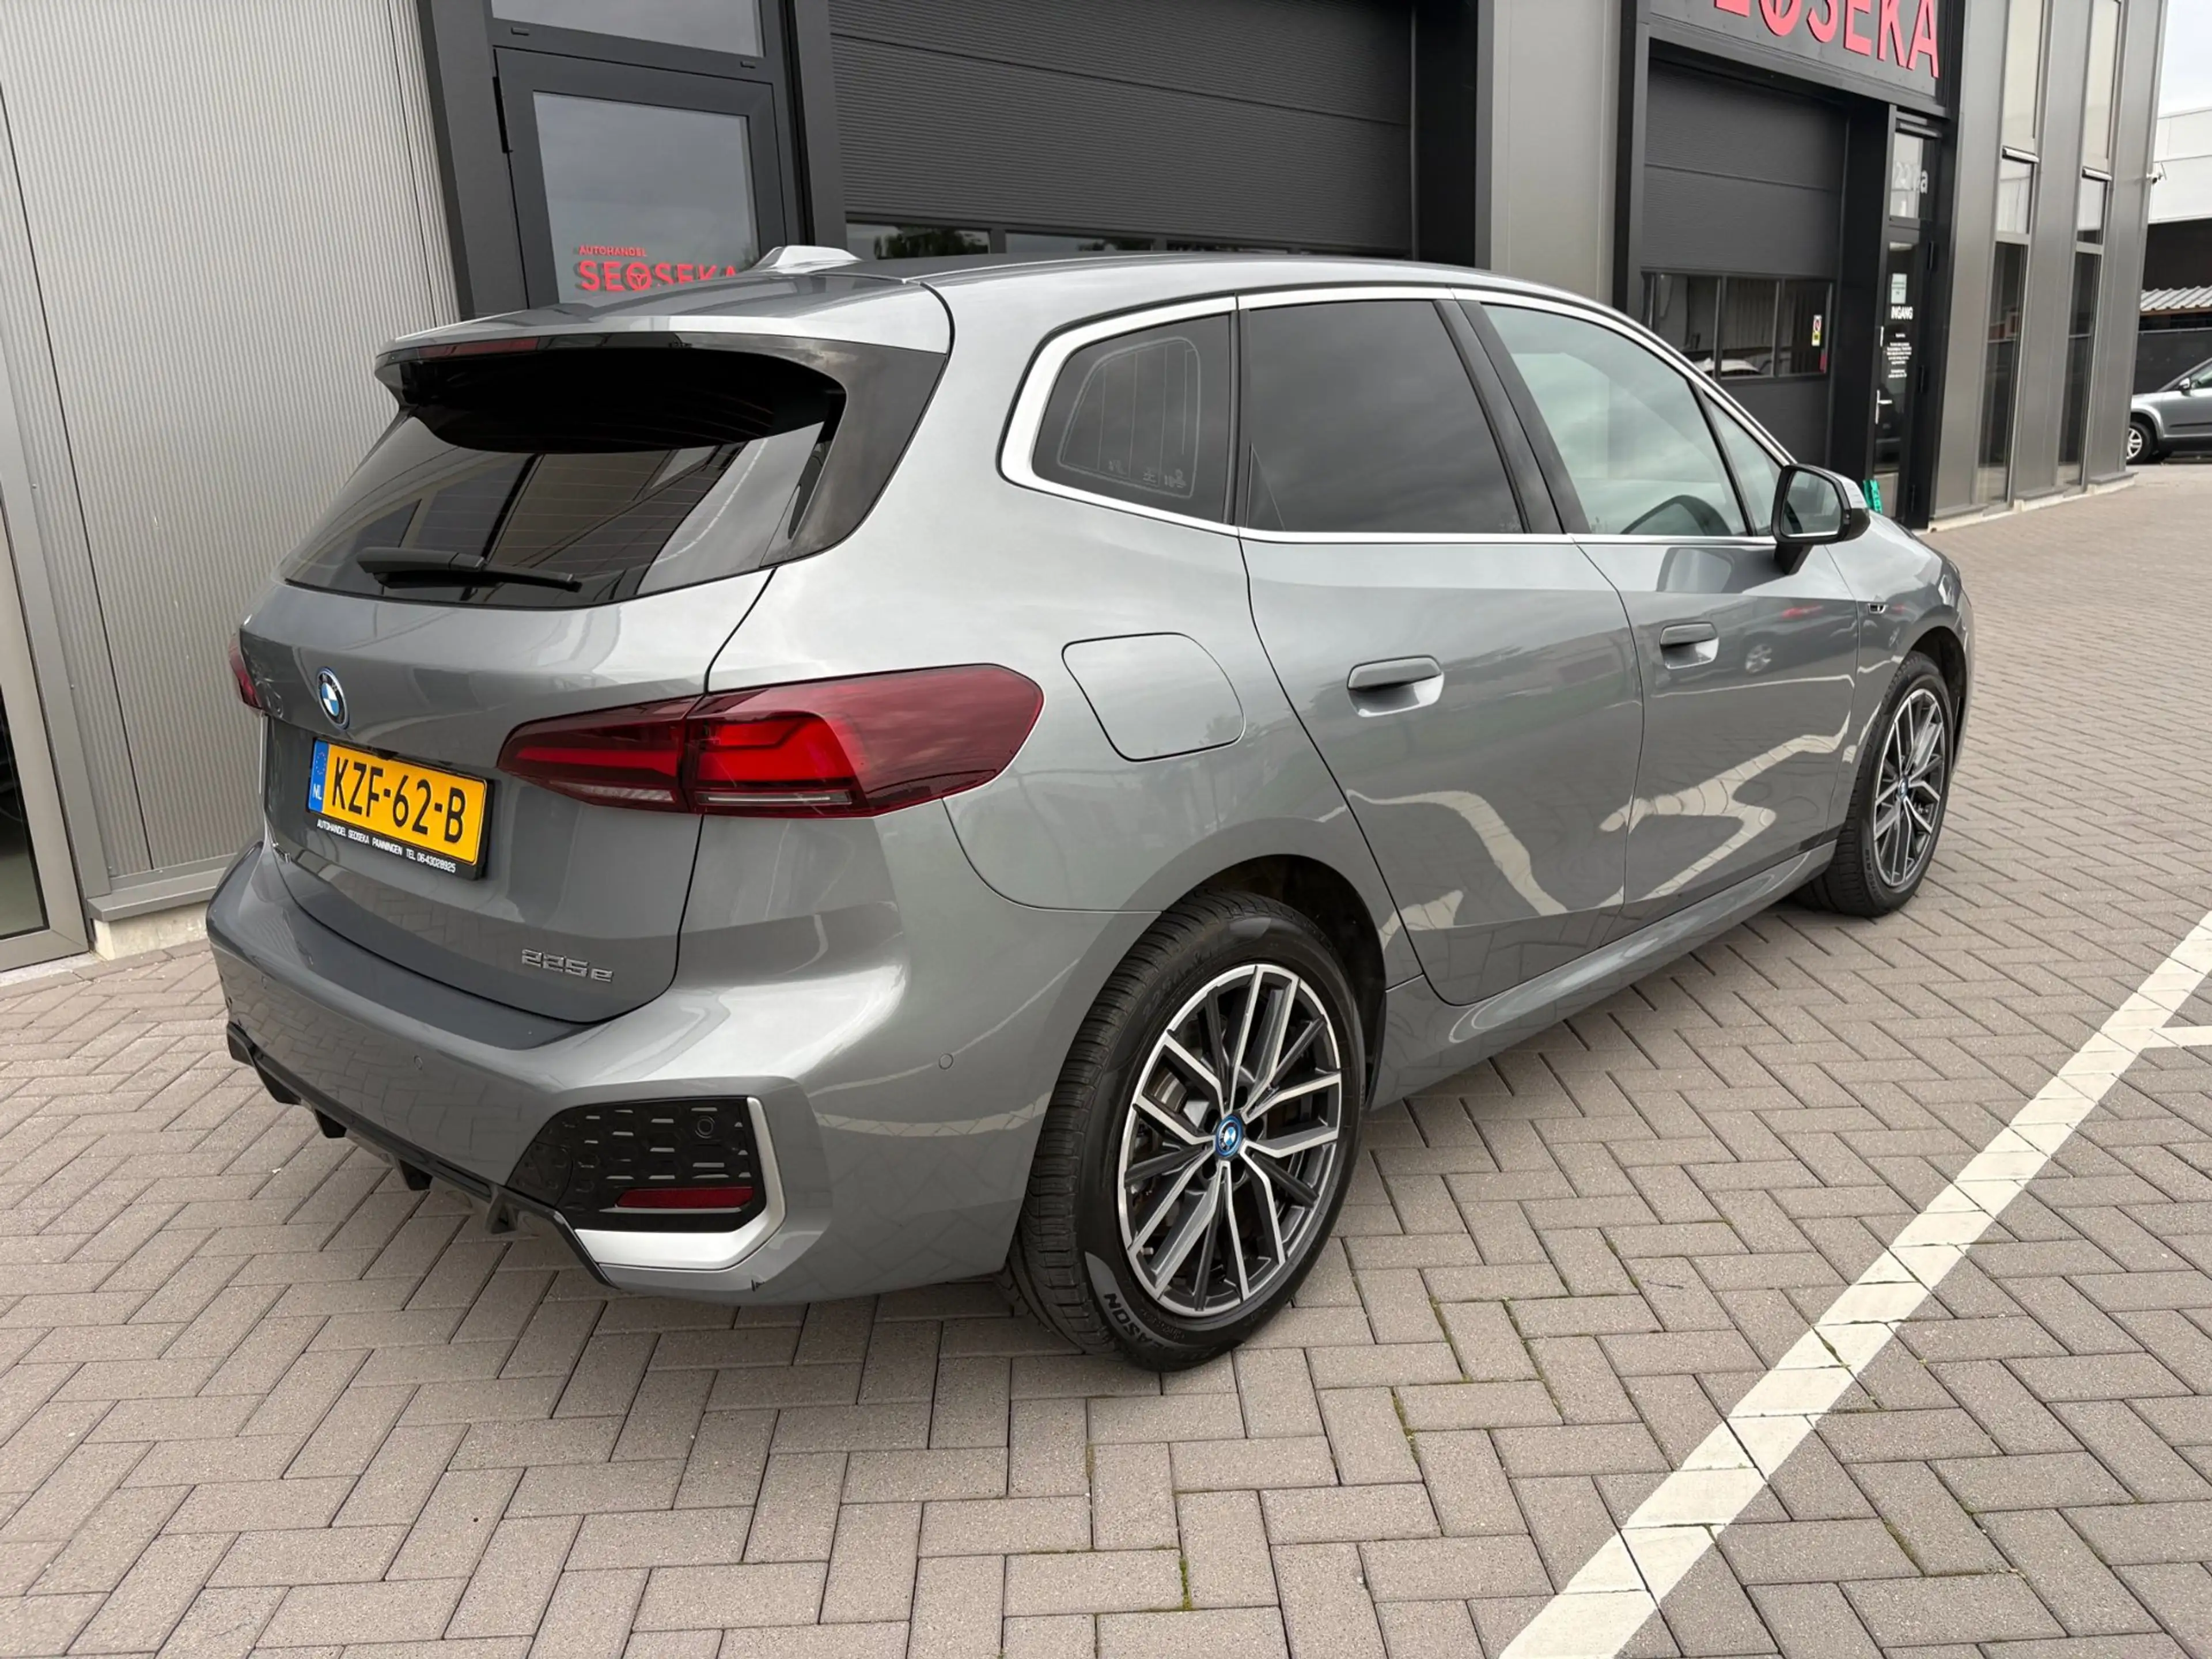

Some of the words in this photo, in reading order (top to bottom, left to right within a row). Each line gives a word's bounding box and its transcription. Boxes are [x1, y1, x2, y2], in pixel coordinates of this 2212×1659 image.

[579, 245, 647, 257] AUTOHANDEL
[312, 784, 323, 801] NL
[332, 756, 467, 844] KZF-62-B
[316, 819, 347, 837] AUTOHANDEL
[347, 829, 370, 844] SEOSEKA
[372, 836, 403, 856] PANNINGEN
[521, 949, 614, 983] 225e
